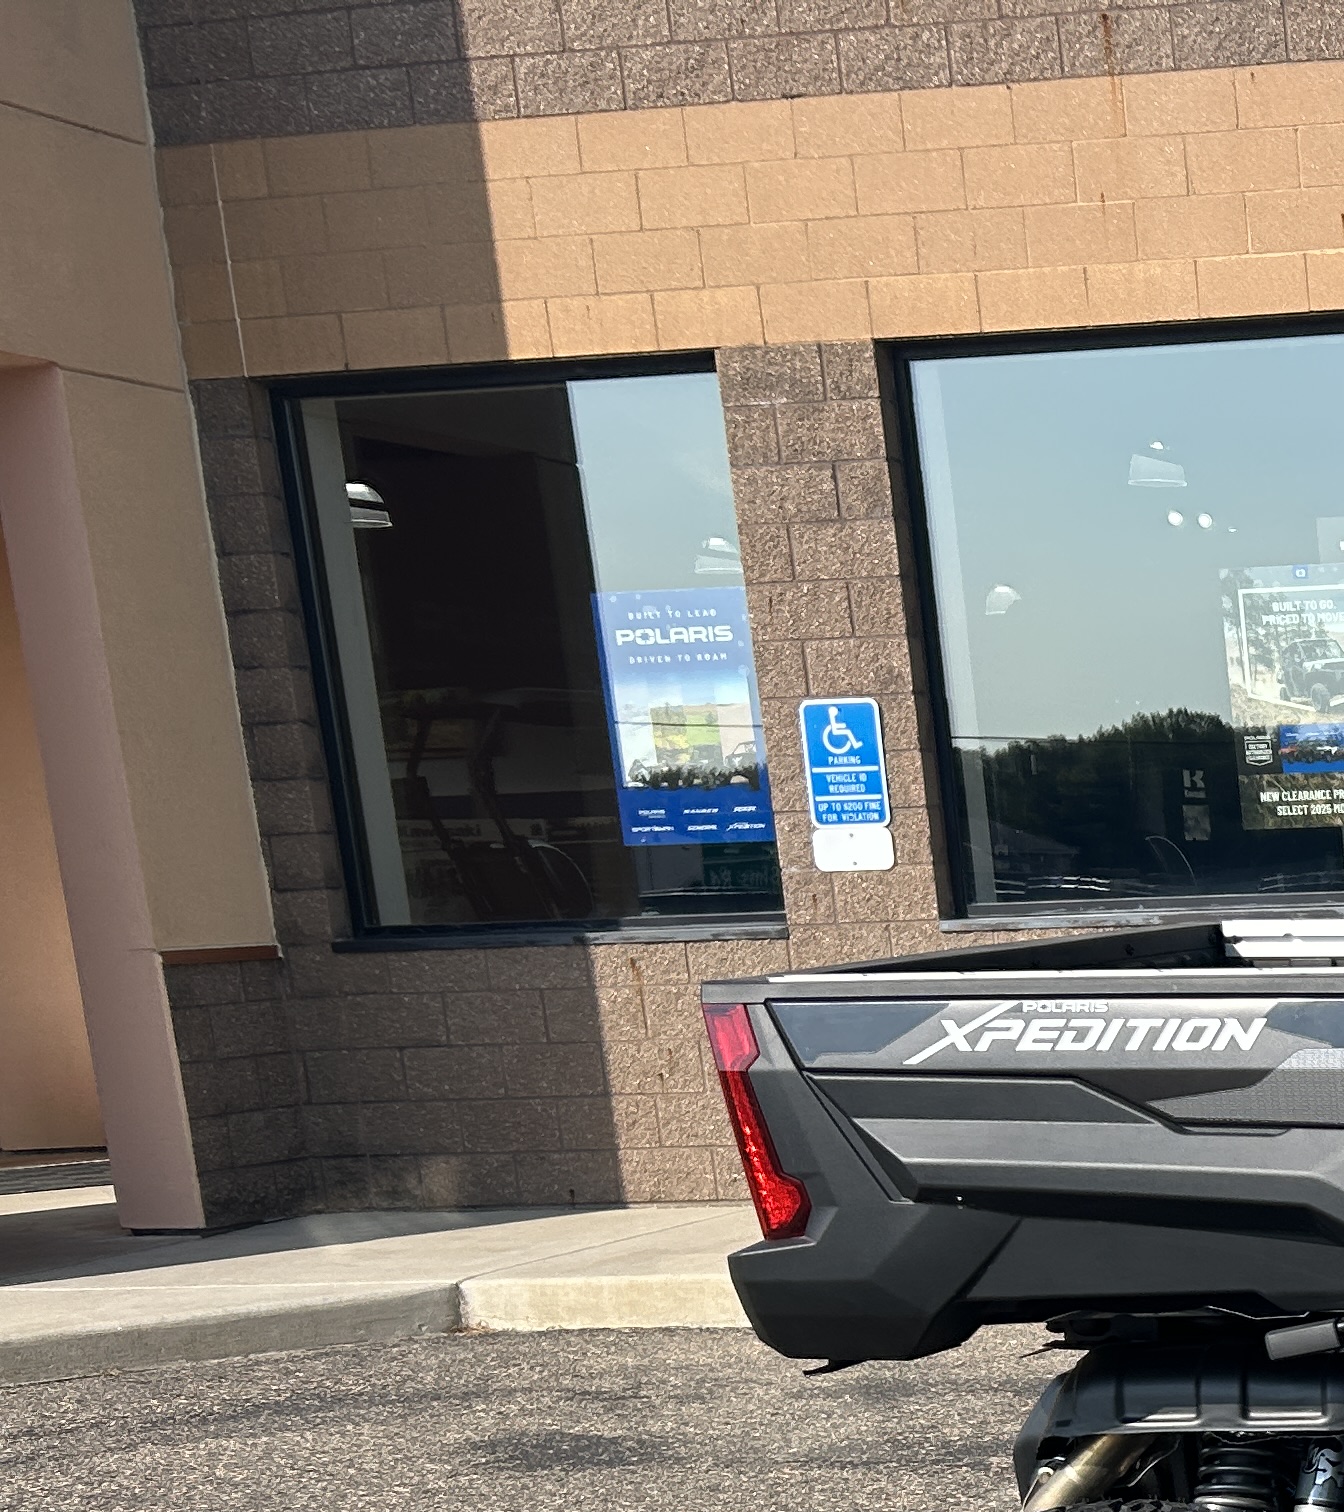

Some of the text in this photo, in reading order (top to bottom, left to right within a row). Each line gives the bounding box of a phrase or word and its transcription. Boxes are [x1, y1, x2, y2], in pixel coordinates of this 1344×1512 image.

[1272, 599, 1337, 612] BUILT TO GO.
[627, 610, 661, 620] BUILT
[667, 609, 681, 618] TO
[1262, 613, 1300, 626] PRICED
[1301, 612, 1316, 624] TO
[615, 625, 734, 646] POLARIS
[629, 655, 671, 664] DRIVEN
[677, 653, 691, 662] TO
[828, 756, 861, 765] PARKING
[826, 773, 867, 783] VEHICLE ID
[829, 784, 866, 793] REQUIRED
[1260, 791, 1280, 802] NEW
[1281, 789, 1333, 801] CLEARANCE
[818, 801, 881, 812] UP TO $200 FINE
[1277, 805, 1309, 816] SELECT
[1310, 804, 1332, 815] 2025
[822, 812, 879, 822] FOR VIOLATION
[1022, 1001, 1109, 1013] POLARIS
[903, 1001, 1268, 1065] XPEDITION
